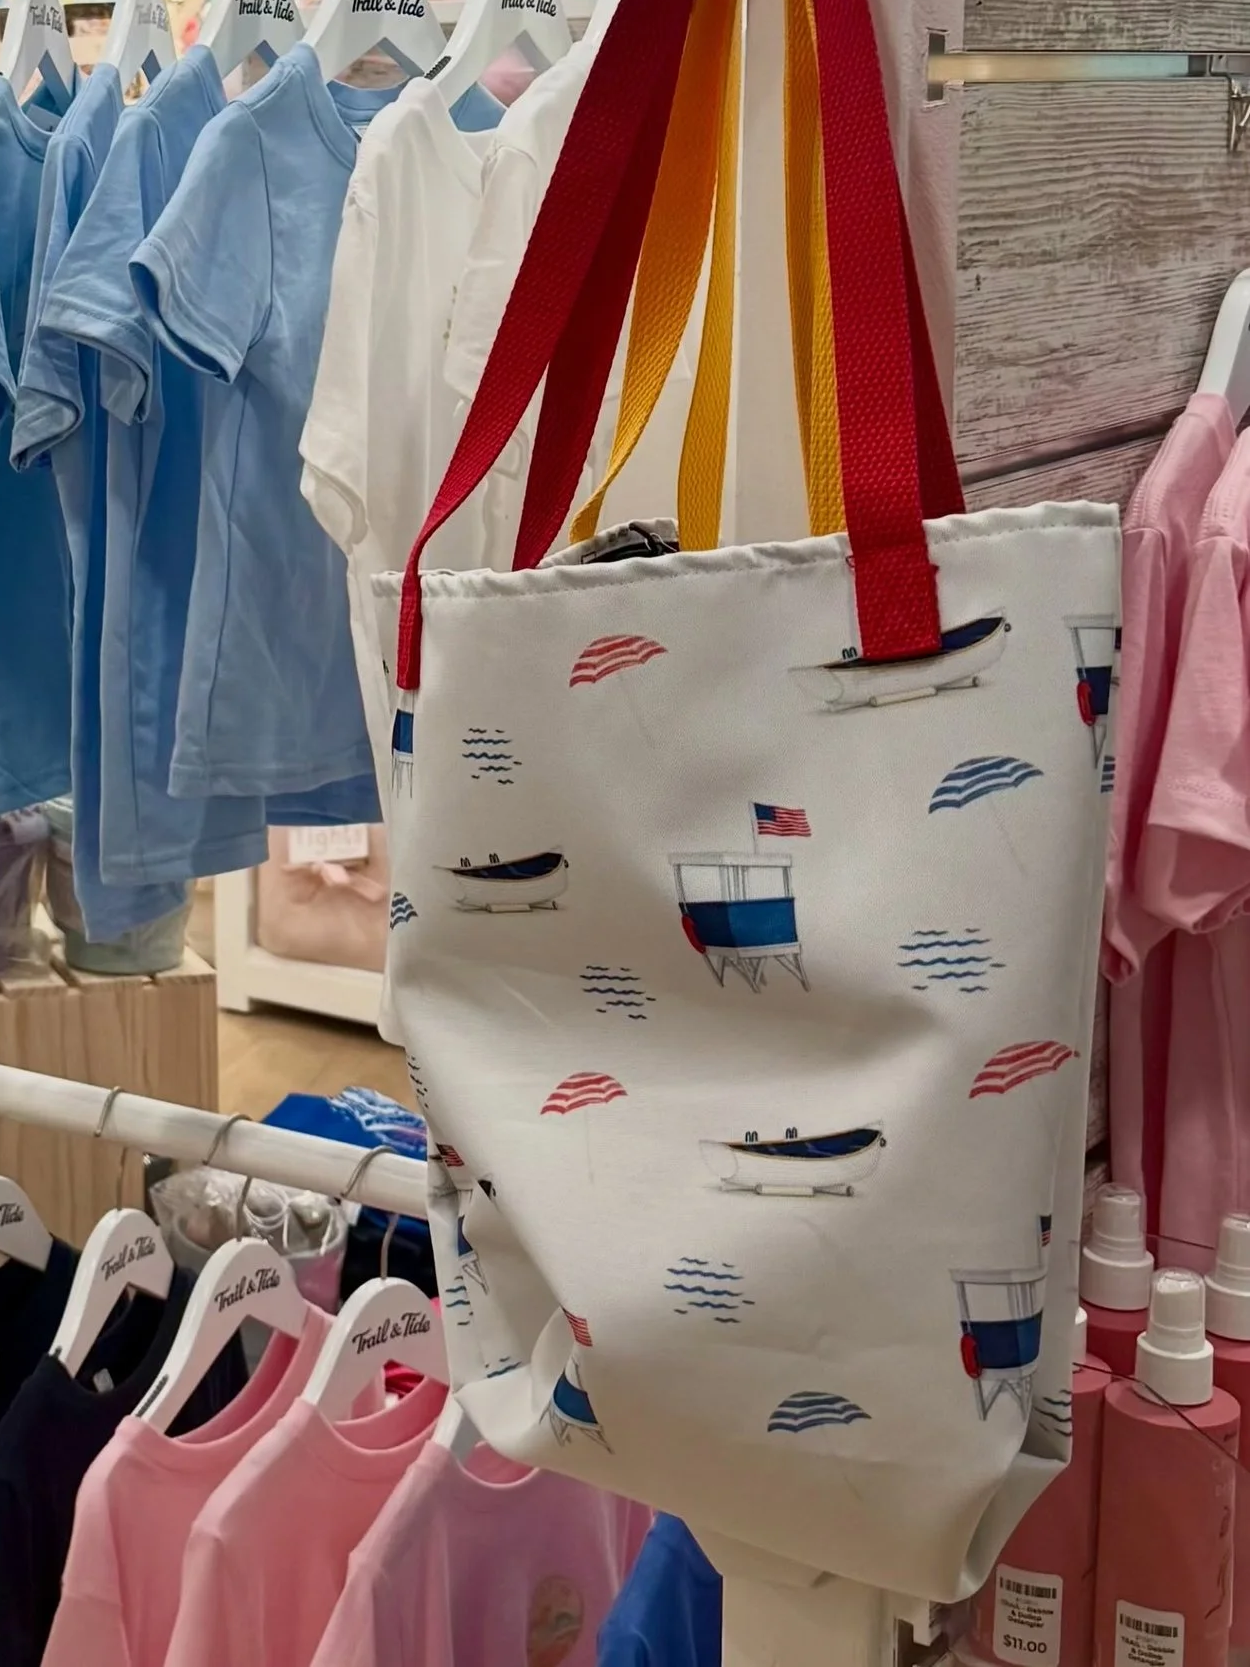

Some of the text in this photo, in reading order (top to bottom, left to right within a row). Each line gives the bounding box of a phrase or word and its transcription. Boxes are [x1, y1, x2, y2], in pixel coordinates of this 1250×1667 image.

[100, 1248, 128, 1281] Trail
[134, 1235, 157, 1259] Tide
[214, 1280, 246, 1312] Trail
[255, 1267, 281, 1291] Tide
[352, 1316, 391, 1354] Trail
[401, 1311, 431, 1335] Tide
[1003, 1633, 1048, 1654] $11.00
